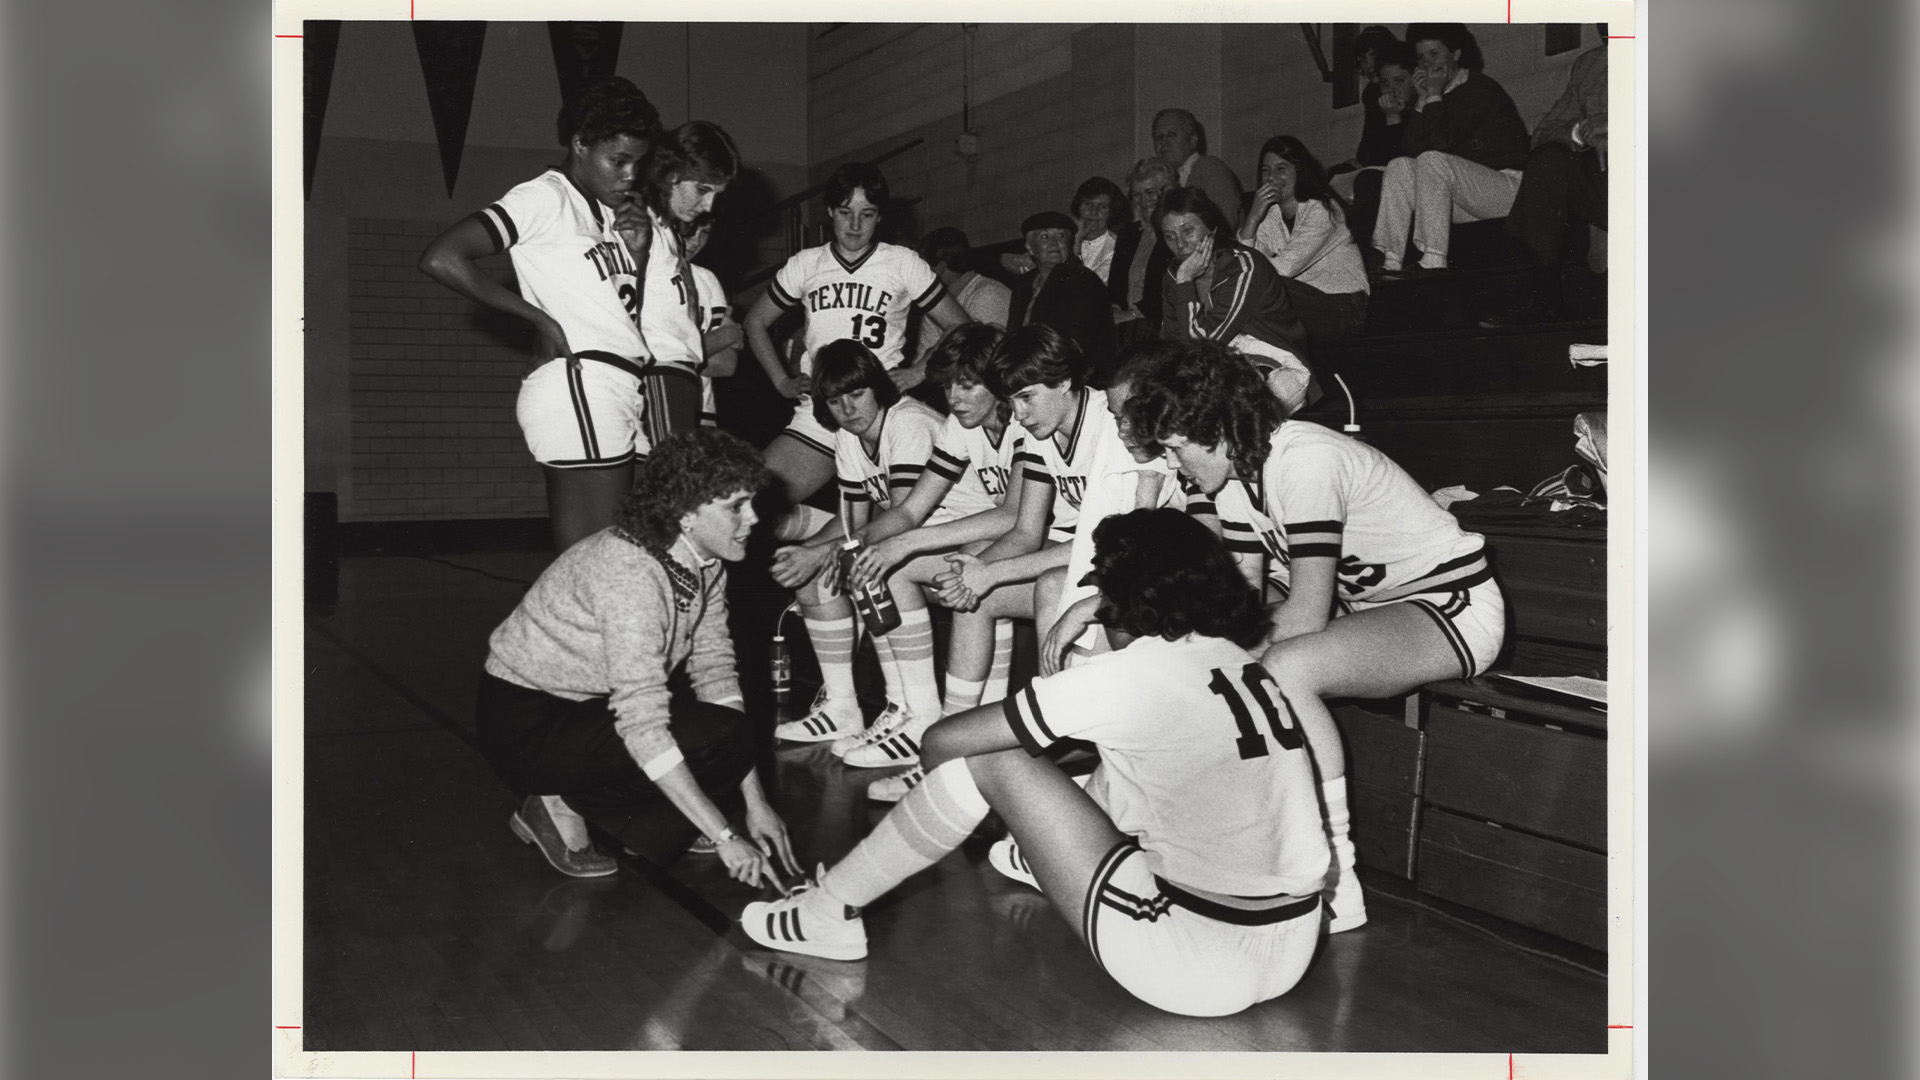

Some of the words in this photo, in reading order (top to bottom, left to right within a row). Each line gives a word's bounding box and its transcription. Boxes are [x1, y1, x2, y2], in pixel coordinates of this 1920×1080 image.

[808, 282, 892, 317] TEXTILE
[851, 313, 887, 349] 13
[1207, 662, 1304, 760] 10
